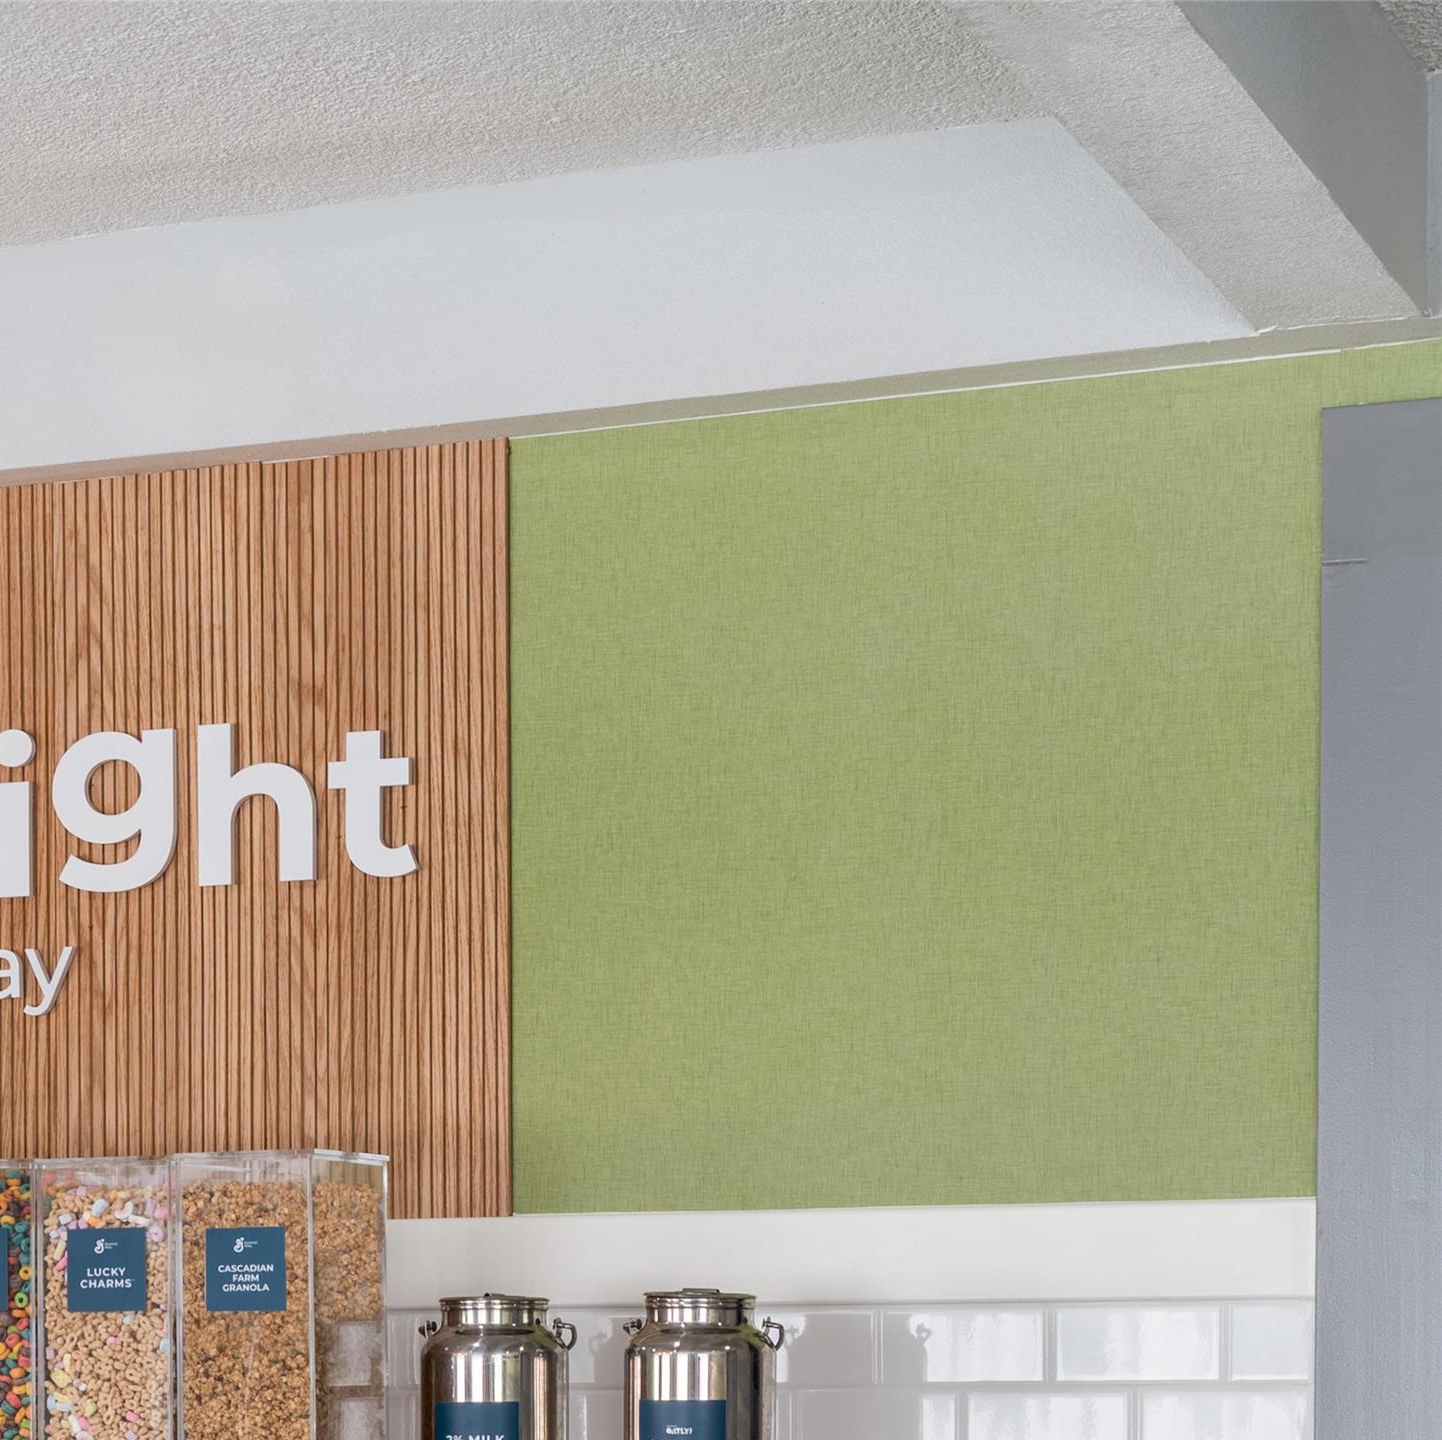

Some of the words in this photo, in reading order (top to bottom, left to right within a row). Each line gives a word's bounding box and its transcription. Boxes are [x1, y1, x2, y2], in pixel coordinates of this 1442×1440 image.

[86, 1267, 126, 1277] LUCKY
[217, 1264, 274, 1273] CASCADIAN
[232, 1274, 260, 1283] FARM
[80, 1279, 132, 1289] CHARMS
[222, 1283, 270, 1292] GRANOLA
